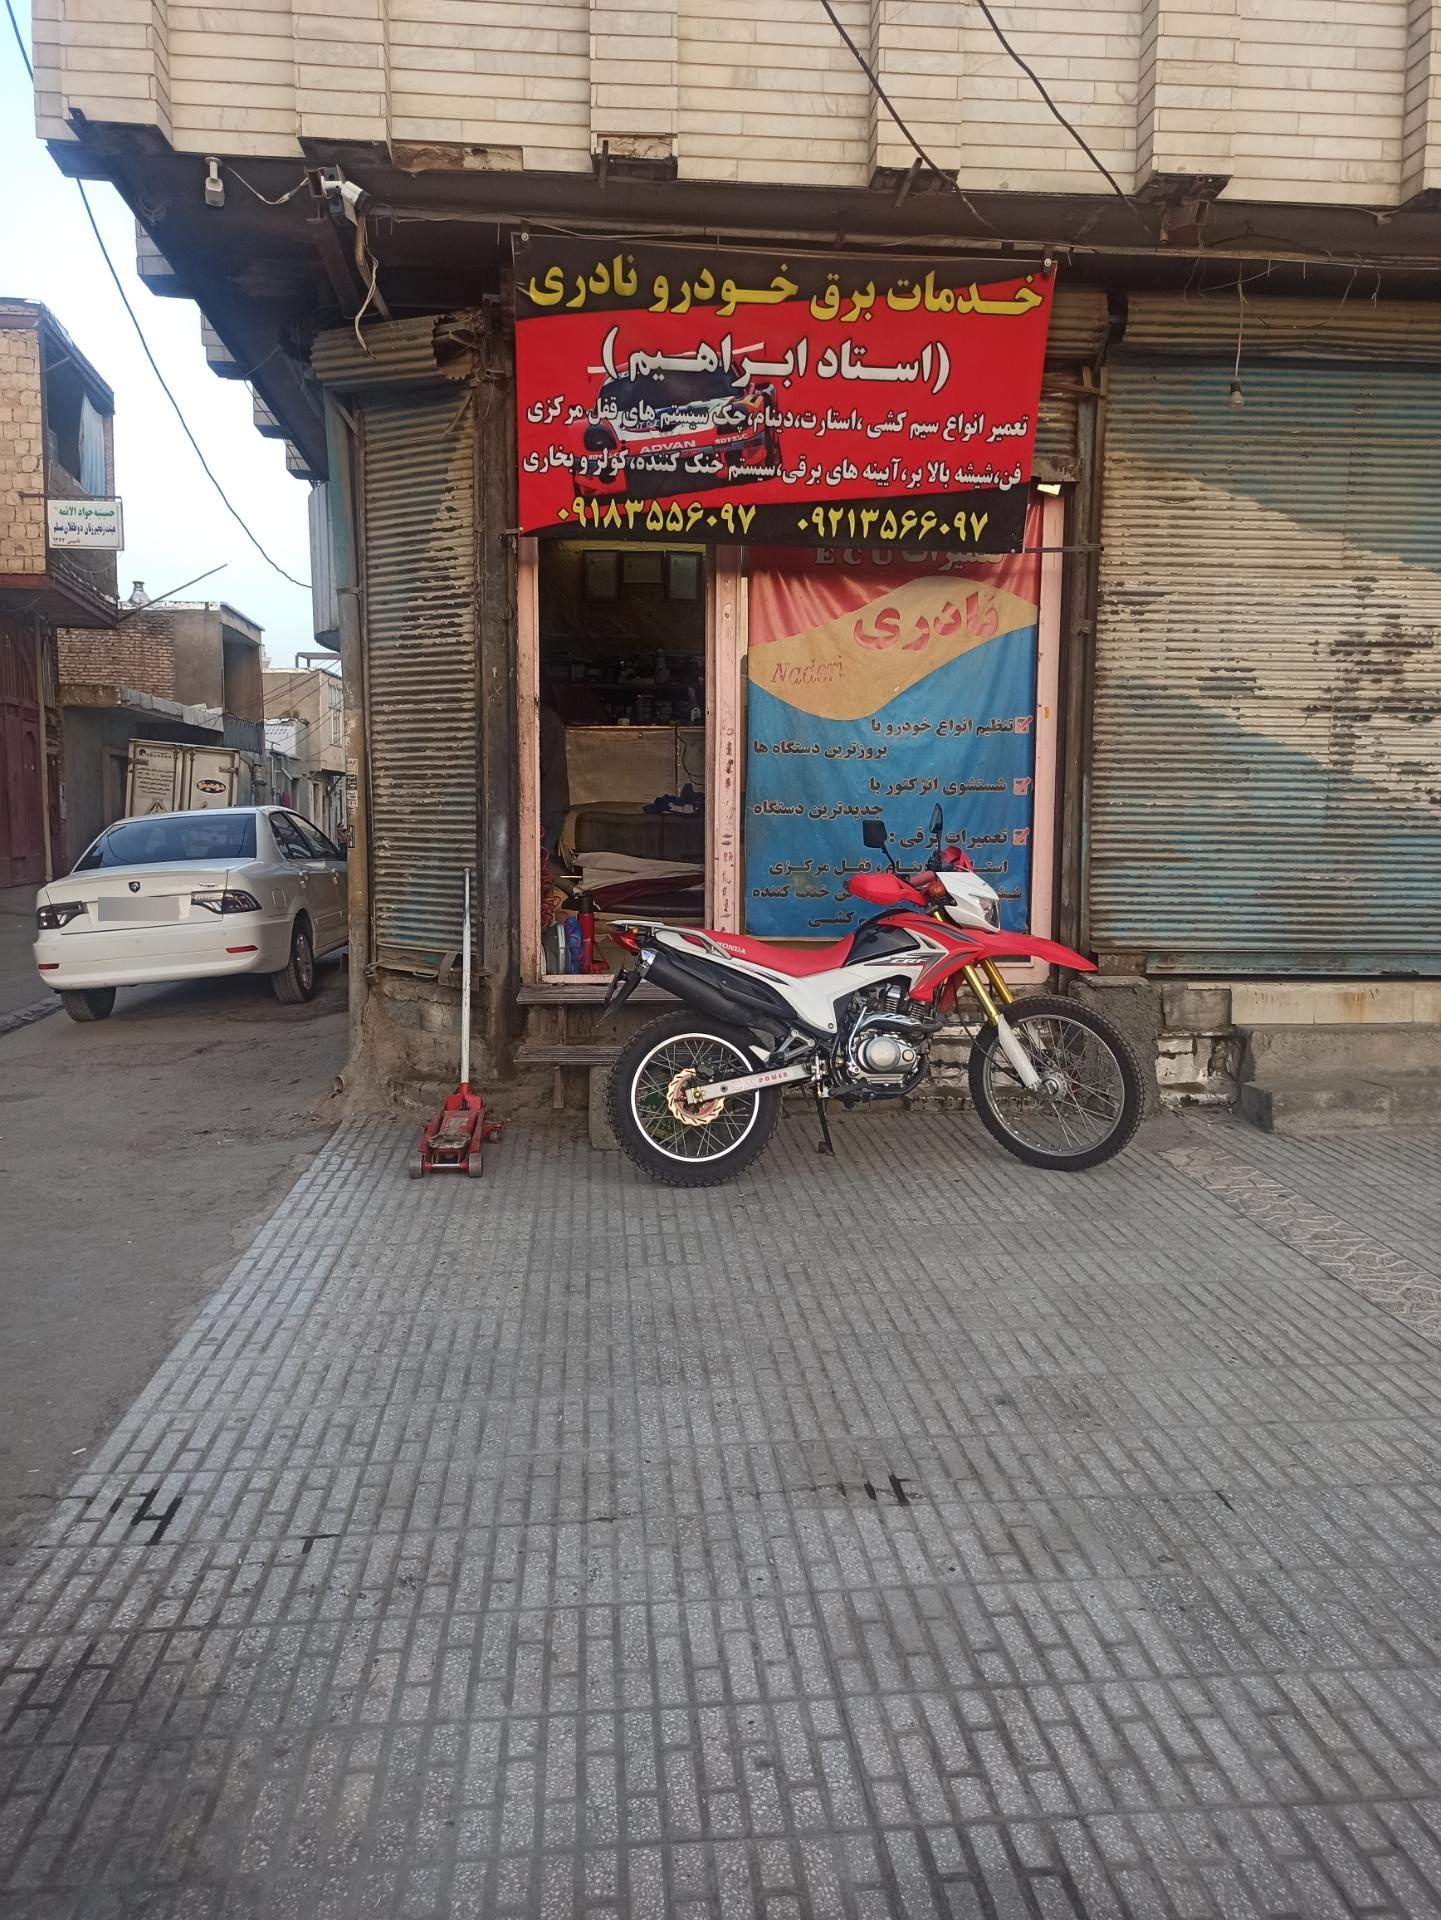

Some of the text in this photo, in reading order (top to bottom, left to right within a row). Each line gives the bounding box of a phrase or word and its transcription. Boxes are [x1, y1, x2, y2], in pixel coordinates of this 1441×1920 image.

[528, 254, 1044, 323] خدمات برق خودرو نادری
[527, 395, 583, 425] مرکزی
[587, 397, 619, 426] قفل
[622, 400, 656, 427] های
[660, 402, 710, 430] سیستم
[866, 410, 908, 438] کشی
[909, 418, 939, 440] سیم
[942, 413, 984, 442] انواع
[986, 415, 1029, 443] تعمیر
[639, 439, 696, 455] ADVAN
[522, 445, 575, 473] بخاری
[579, 460, 589, 475] و
[684, 453, 724, 474] خنک
[825, 458, 858, 486] های
[557, 495, 989, 543] ۰۹۱۸۳۵۵۶۰۹۷ ۰۹۲۱۳۵۶۶۰۹۷
[853, 590, 1000, 651] نادری
[871, 718, 1014, 737] تنظیم انواع خودرو با
[753, 740, 768, 755] ها
[772, 741, 820, 755] دستگاه
[870, 776, 1007, 796] شستشوی انژکتور با
[753, 800, 804, 815] دستگاه
[944, 829, 1008, 849] تعمیرات
[769, 859, 829, 875] مرکزی
[833, 859, 871, 875] قفل
[752, 884, 790, 898] کننده
[808, 911, 854, 928] کشی
[758, 1072, 788, 1084] POWER
